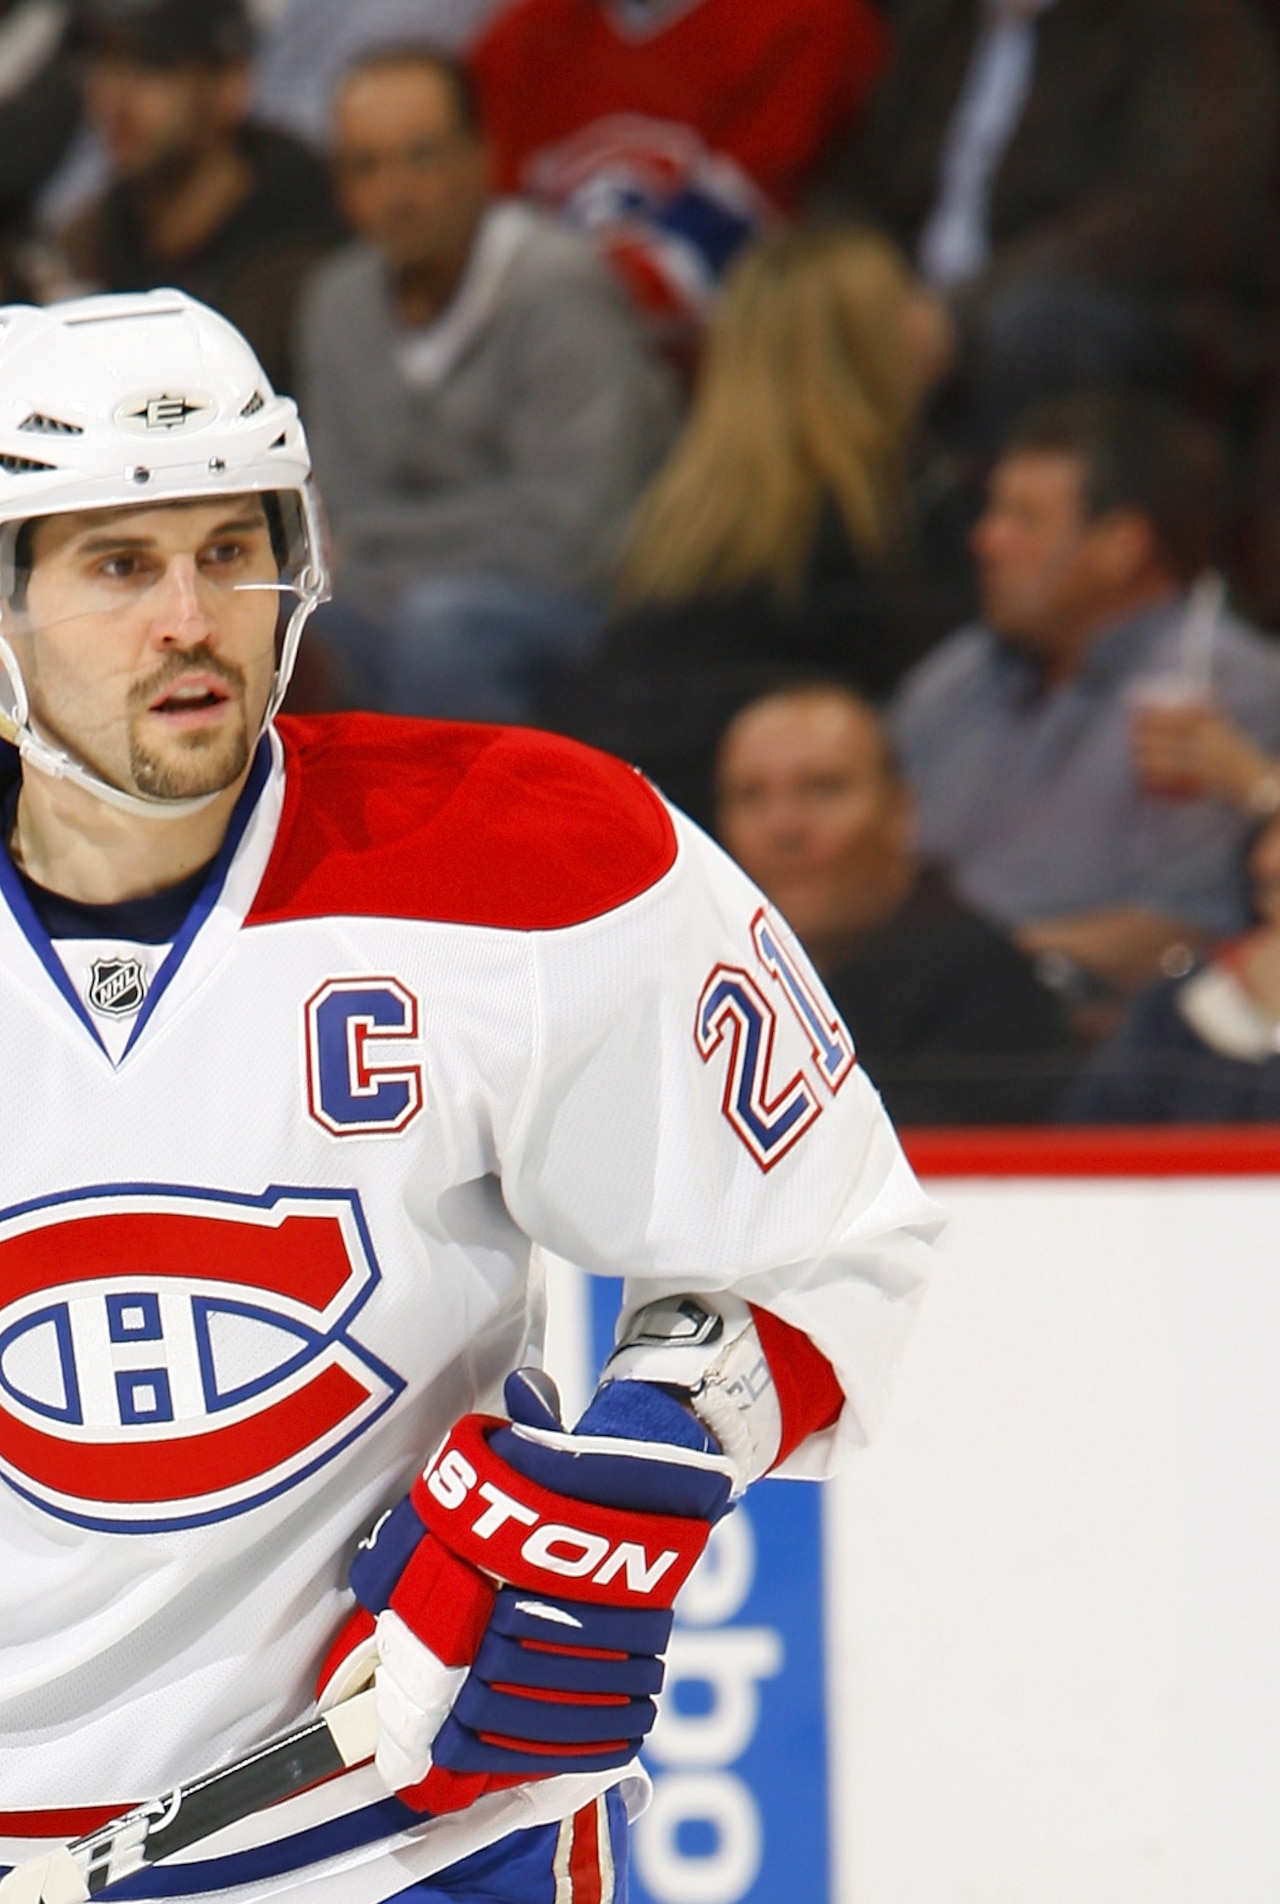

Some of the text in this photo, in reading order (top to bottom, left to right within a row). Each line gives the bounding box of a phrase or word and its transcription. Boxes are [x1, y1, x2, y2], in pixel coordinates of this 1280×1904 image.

[99, 969, 136, 1006] NHL
[305, 976, 422, 1138] C
[694, 907, 857, 1174] 21
[422, 1432, 679, 1595] STON
